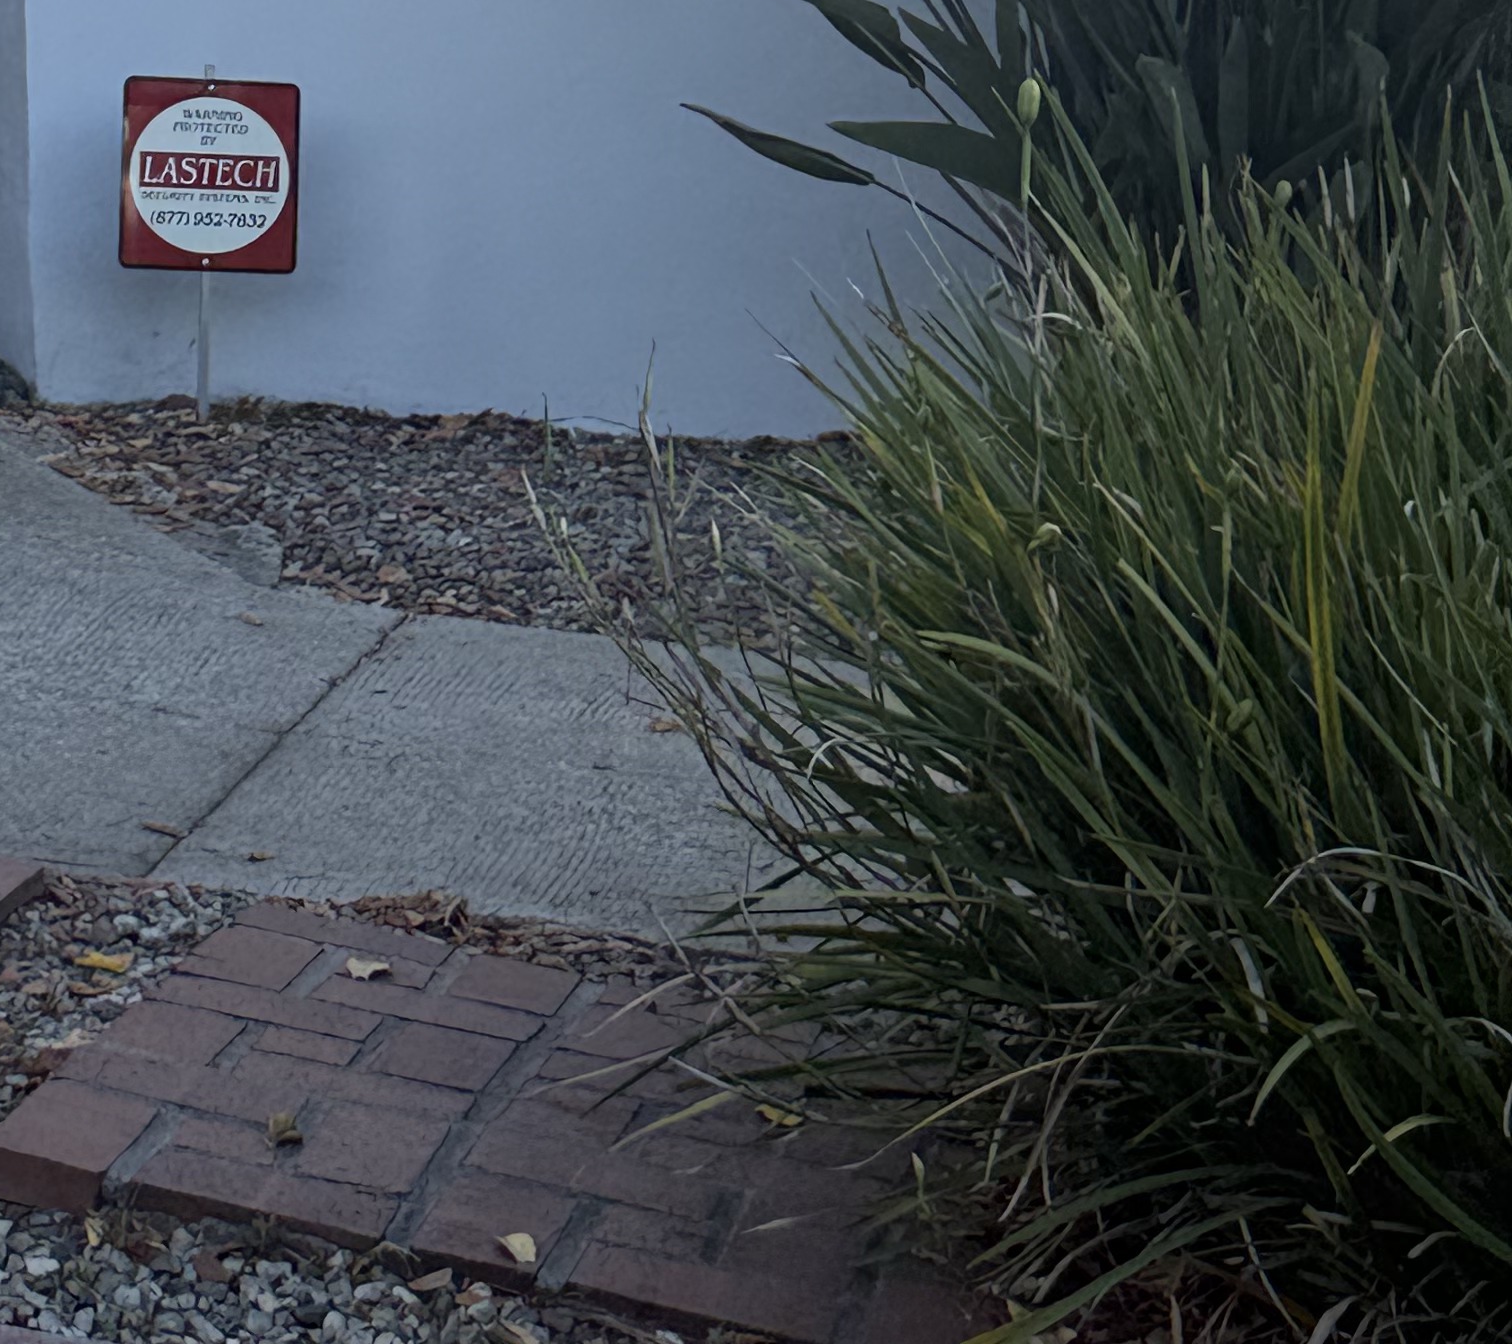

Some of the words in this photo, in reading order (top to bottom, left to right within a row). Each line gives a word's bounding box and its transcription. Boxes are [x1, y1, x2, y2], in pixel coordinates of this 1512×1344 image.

[173, 121, 249, 135] PROTECTED
[200, 135, 217, 146] BY
[143, 155, 277, 188] LASTECH
[150, 210, 190, 226] (877)
